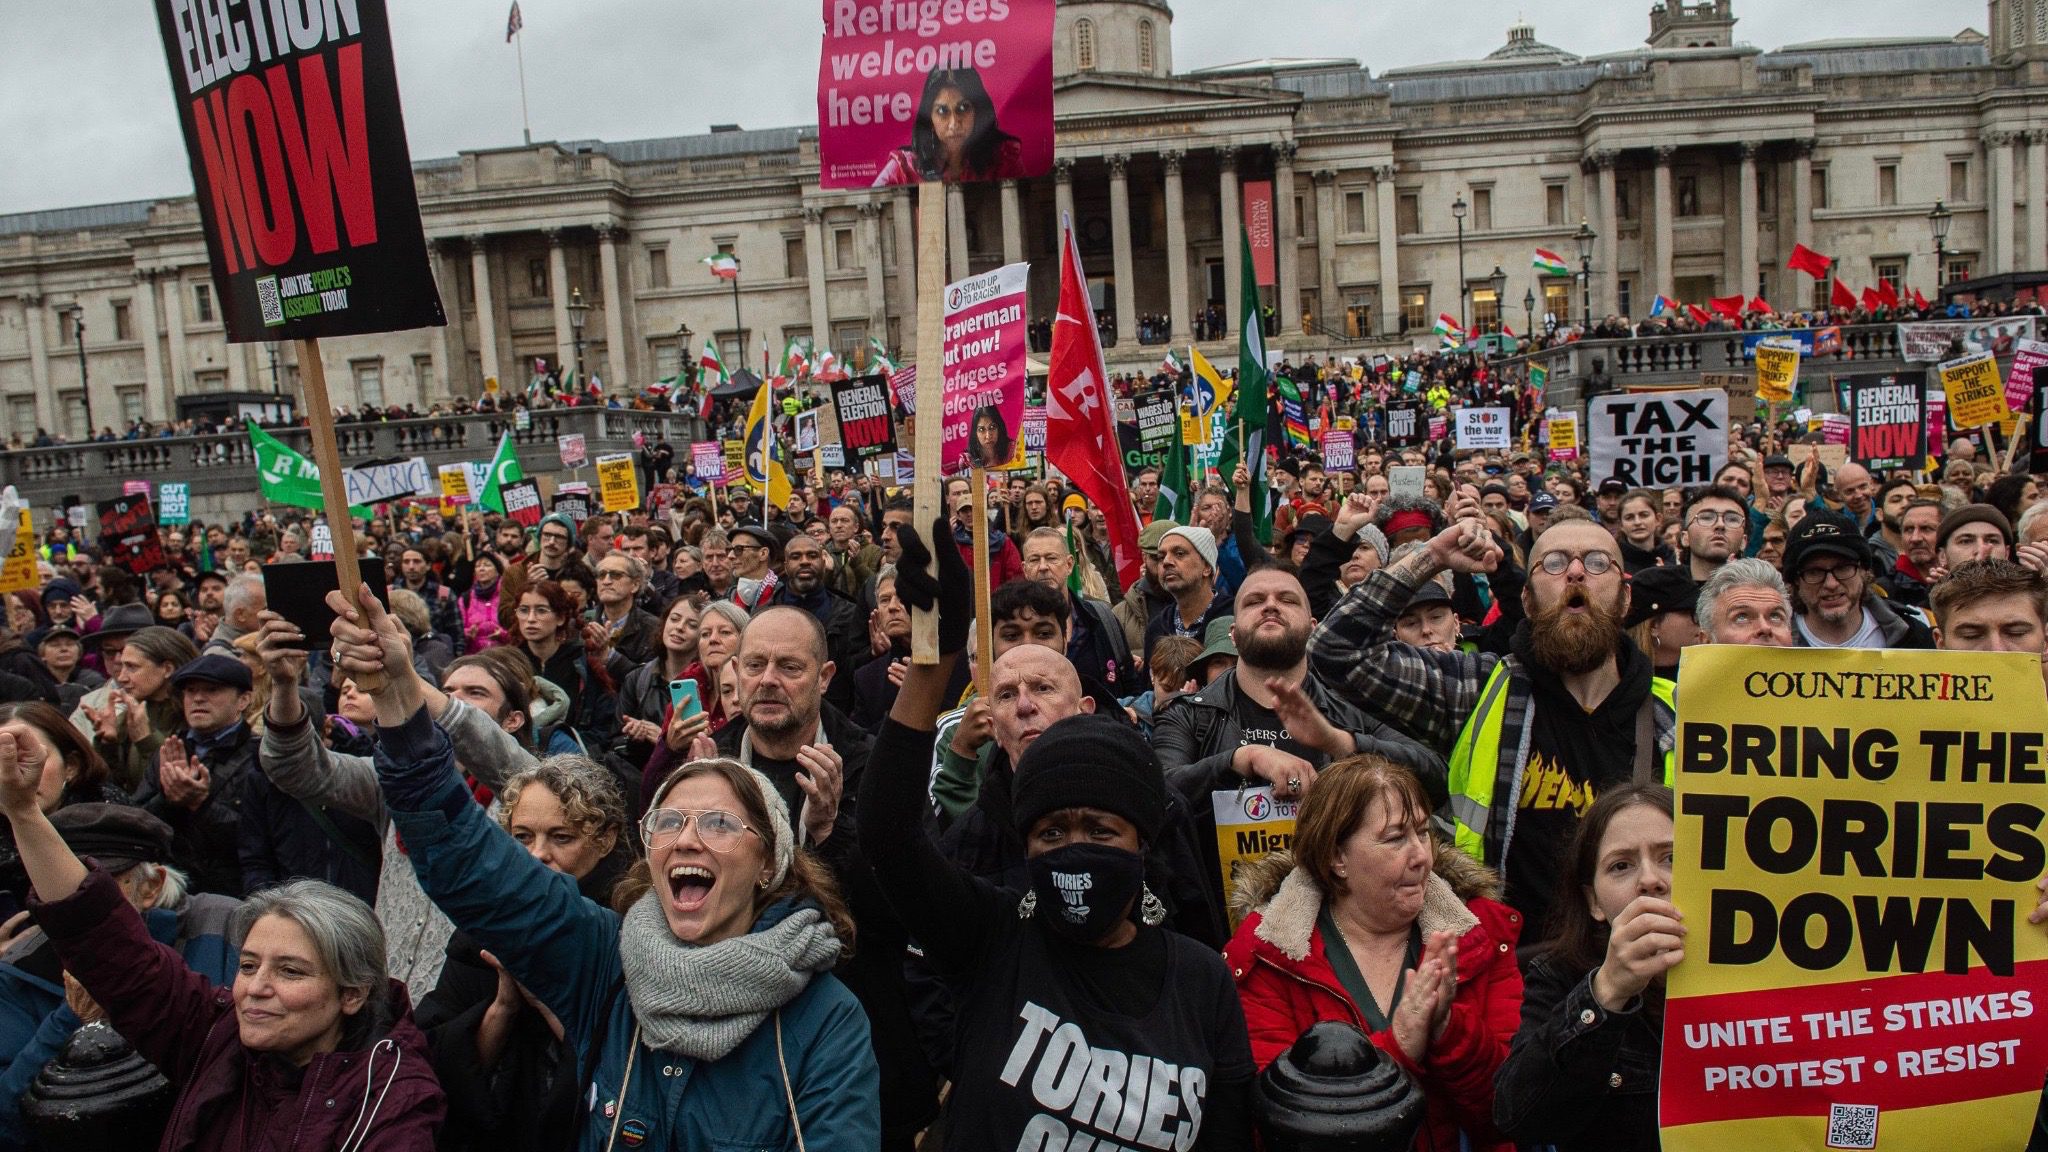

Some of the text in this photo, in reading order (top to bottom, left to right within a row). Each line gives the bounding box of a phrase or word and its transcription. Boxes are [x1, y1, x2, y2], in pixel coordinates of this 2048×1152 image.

[834, 0, 1010, 38] Refugees
[171, 0, 361, 94] ELECTION
[831, 38, 997, 81] welcome
[828, 88, 912, 127] here
[192, 43, 378, 275] NOW
[1252, 200, 1261, 247] NATIONAL
[1260, 199, 1270, 247] GALLERY
[280, 266, 352, 297] JOIN THE PEOPLE'S
[963, 275, 998, 295] STAND UP
[284, 289, 348, 318] ASSEMBLY TODAY
[964, 284, 1001, 306] TO RACISM
[944, 329, 1001, 367] ut now!
[1758, 349, 1795, 363] SUPPORT
[1766, 361, 1782, 370] THE
[1946, 361, 1991, 383] SUPPORT
[2013, 362, 2031, 372] out
[1703, 375, 1723, 385] GET
[1962, 376, 1982, 390] THE
[837, 384, 885, 407] GENERAL
[944, 388, 1004, 416] elcome
[1857, 384, 1920, 408] GENERAL
[1954, 384, 1996, 405] STRIKES
[840, 400, 888, 422] ELECTION
[1137, 403, 1163, 420] WAGES
[1161, 399, 1173, 414] UP
[1388, 409, 1416, 421] TORIES
[1606, 398, 1721, 436] TAX
[1857, 403, 1920, 426] ELECTION
[842, 415, 890, 449] NOW
[1140, 416, 1156, 430] BILLS
[1155, 413, 1175, 426] DOWN
[1141, 423, 1175, 440] TORIES OUT
[1388, 419, 1417, 437] OUT
[1464, 425, 1503, 436] the war
[1325, 441, 1352, 450] GENERAL
[1621, 435, 1697, 455] THE
[1857, 422, 1920, 460] NOW
[1326, 448, 1353, 457] ELECTION
[1326, 455, 1353, 468] NOW
[600, 461, 630, 474] SUPPORT
[611, 472, 622, 481] THE
[696, 464, 720, 477] NOW
[1613, 454, 1711, 487] RICH
[160, 483, 187, 494] CUT
[605, 480, 632, 491] STRIKES
[160, 494, 188, 504] WAR
[161, 503, 187, 513] NOT
[1744, 671, 1994, 702] COUNTERFIRE
[1279, 729, 1293, 739] O
[1682, 722, 2047, 784] BRING THE
[1276, 806, 1289, 817] TO
[1682, 793, 2047, 883] TORIES
[1051, 871, 1093, 890] TORIES
[1061, 890, 1084, 905] OUT
[1709, 888, 2016, 977] DOWN
[1683, 990, 2035, 1049] UNITE THE STRIKES
[1704, 1039, 2021, 1091] PROTEST RESIST
[999, 1001, 1206, 1152] TORIES
